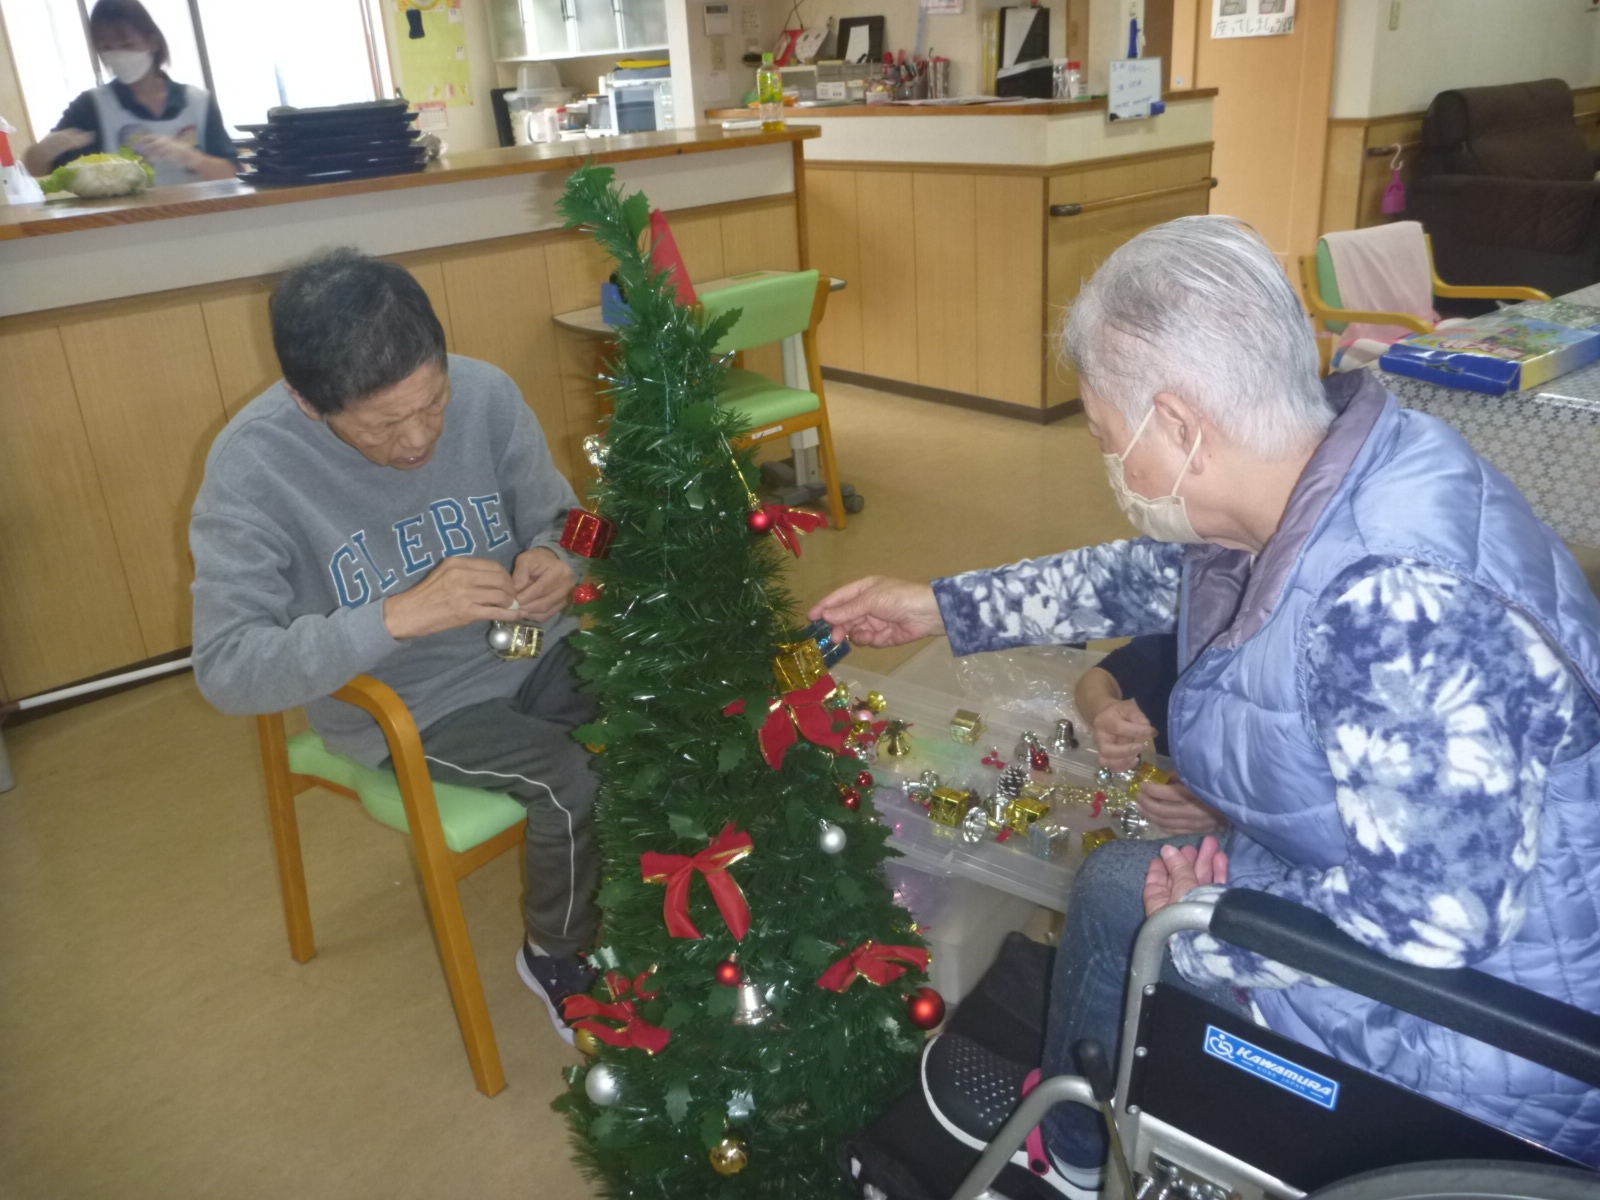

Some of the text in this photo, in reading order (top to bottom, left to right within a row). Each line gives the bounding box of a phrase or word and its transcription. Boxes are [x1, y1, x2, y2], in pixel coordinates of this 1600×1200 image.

[329, 493, 510, 609] GLEBE
[1235, 1047, 1332, 1095] KAWAMURA
[1281, 1077, 1305, 1092] JAPAN
